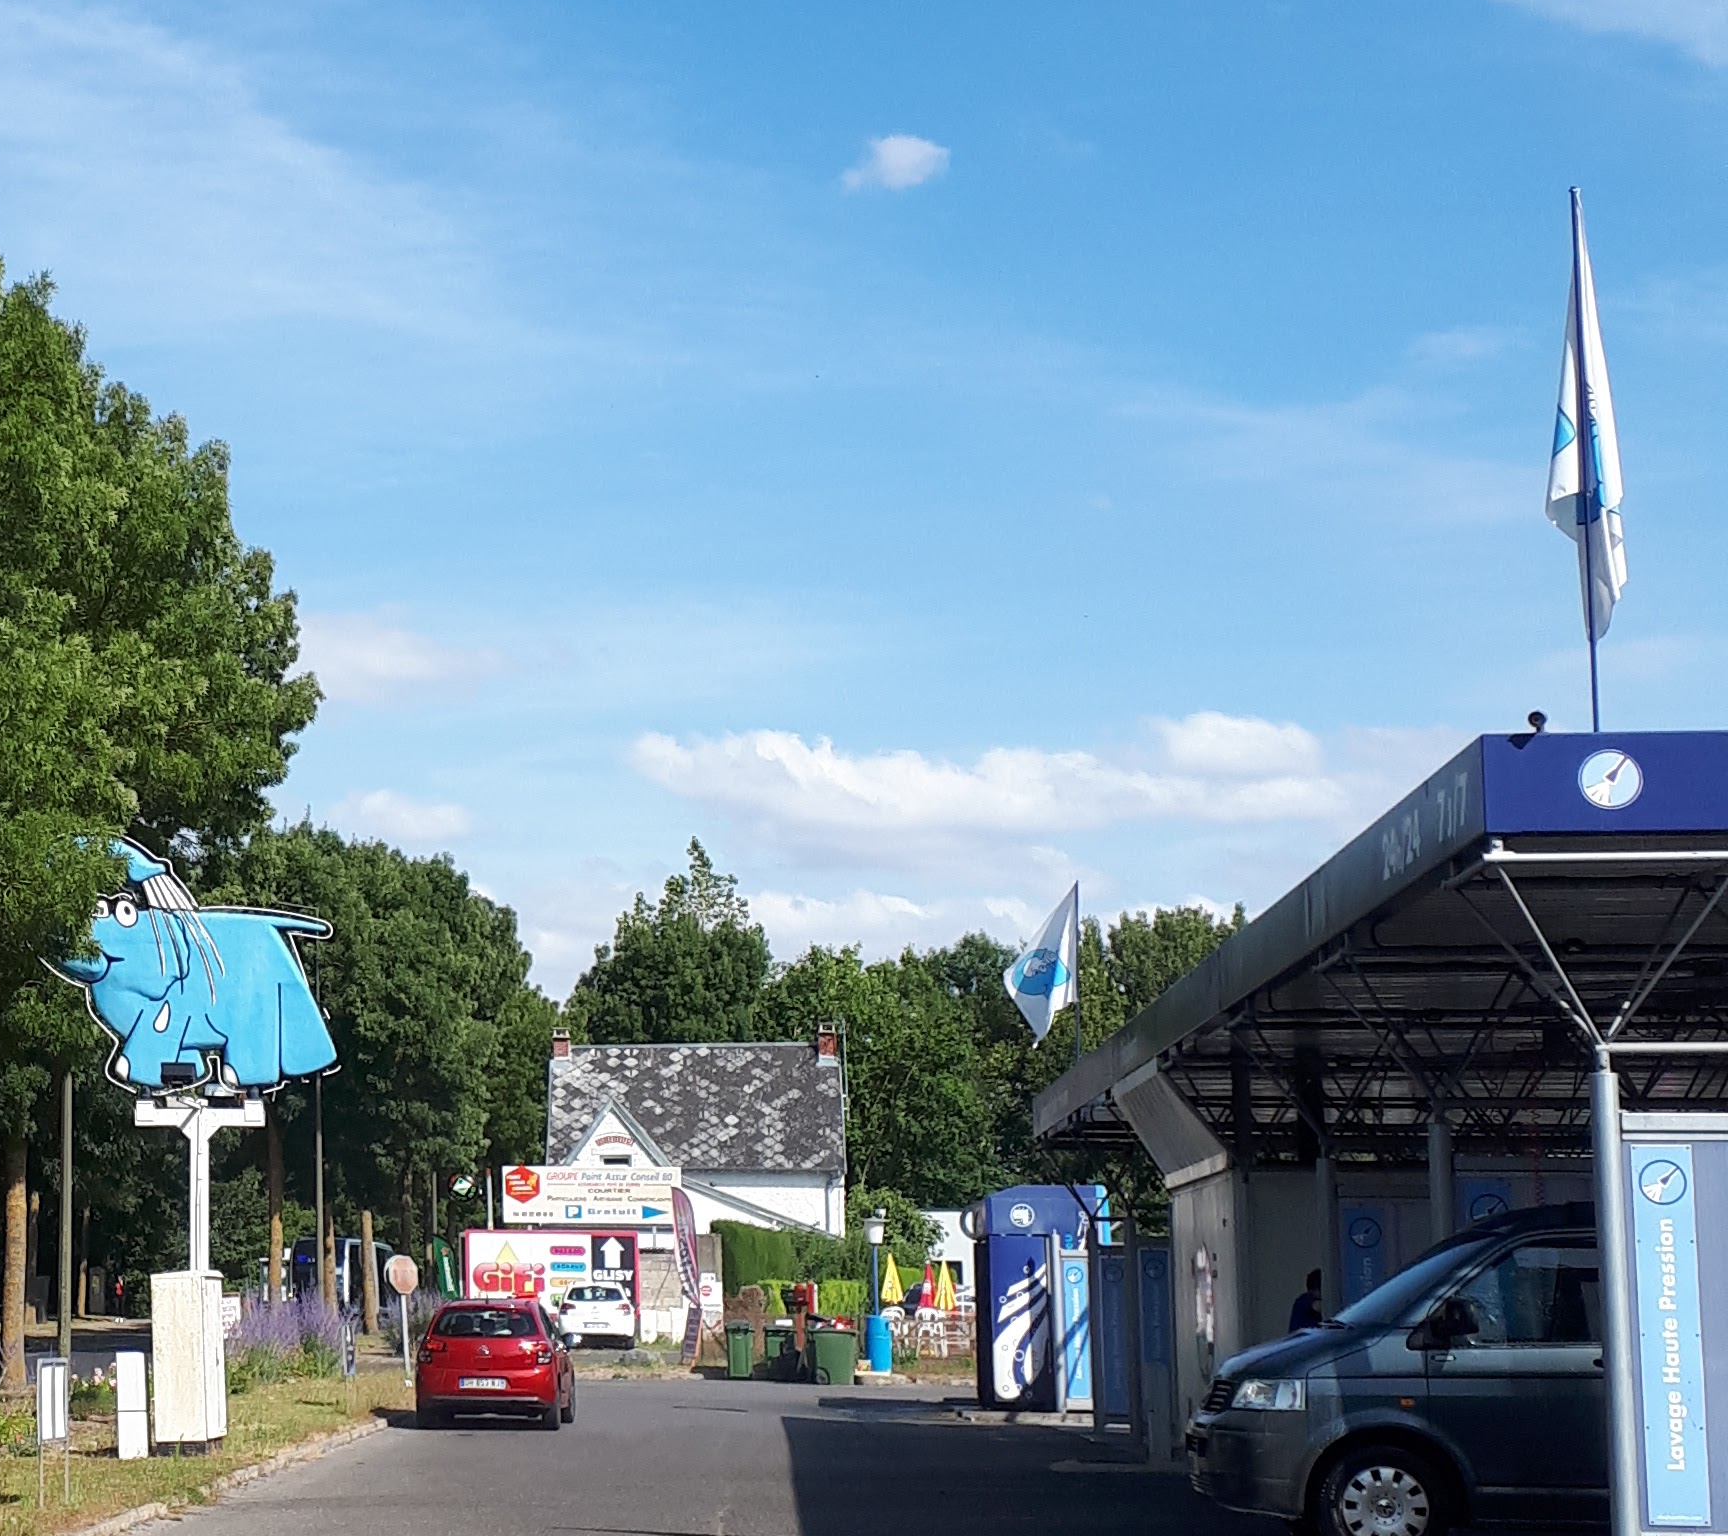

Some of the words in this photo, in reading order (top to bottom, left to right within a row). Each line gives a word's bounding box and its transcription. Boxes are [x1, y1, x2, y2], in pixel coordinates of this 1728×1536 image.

[593, 1269, 634, 1281] GLISY
[1656, 1218, 1679, 1312] Pression
[1659, 1315, 1682, 1384] Haute
[1666, 1390, 1688, 1471] Lavage
